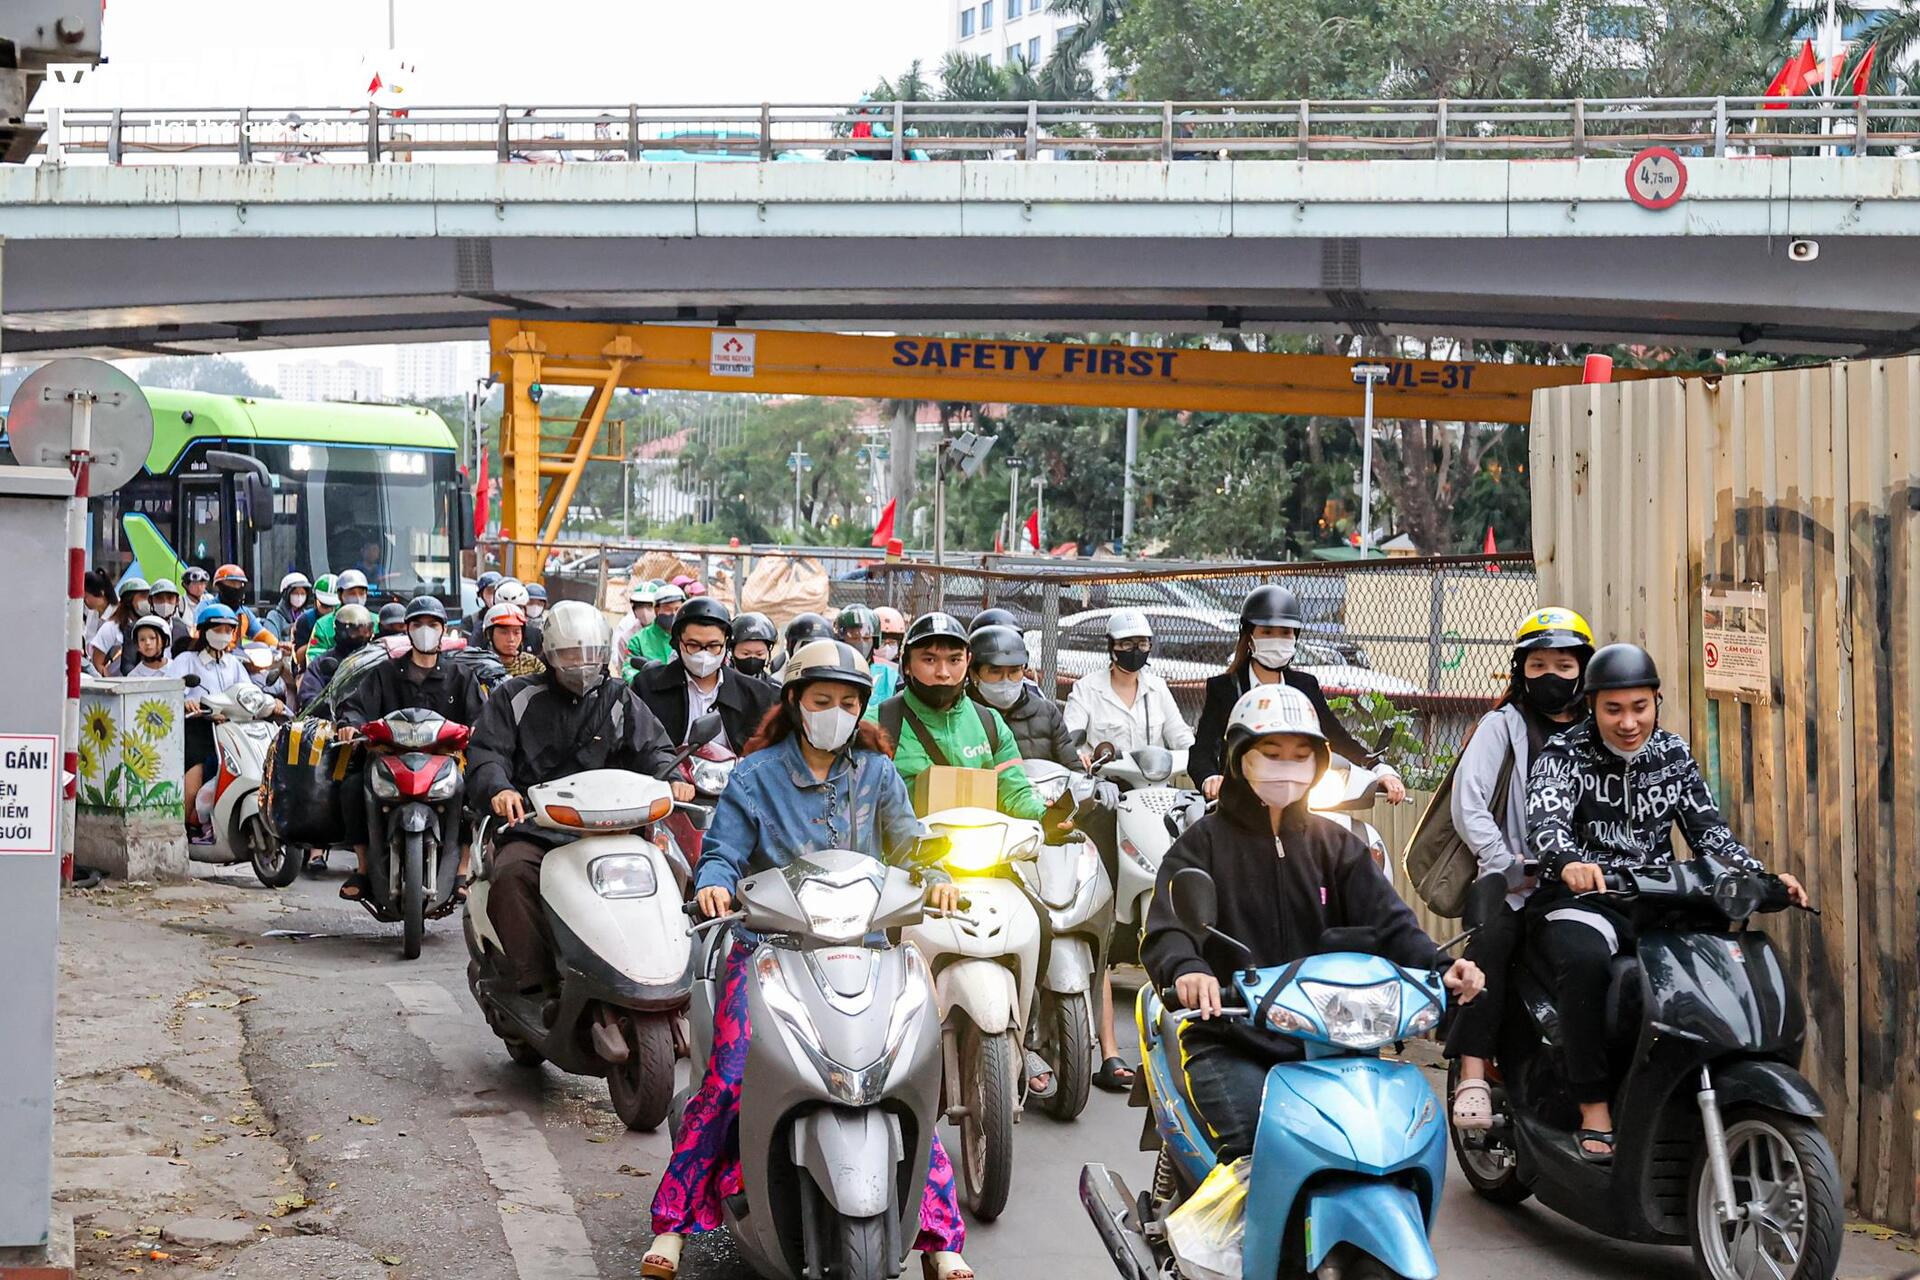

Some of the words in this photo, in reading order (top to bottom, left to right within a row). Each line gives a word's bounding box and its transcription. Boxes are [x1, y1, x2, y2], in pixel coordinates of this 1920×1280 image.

[1641, 166, 1673, 185] 4,75m
[892, 340, 1047, 371] SAFETY
[1063, 347, 1178, 376] FIRST
[1341, 1065, 1380, 1074] HONDA
